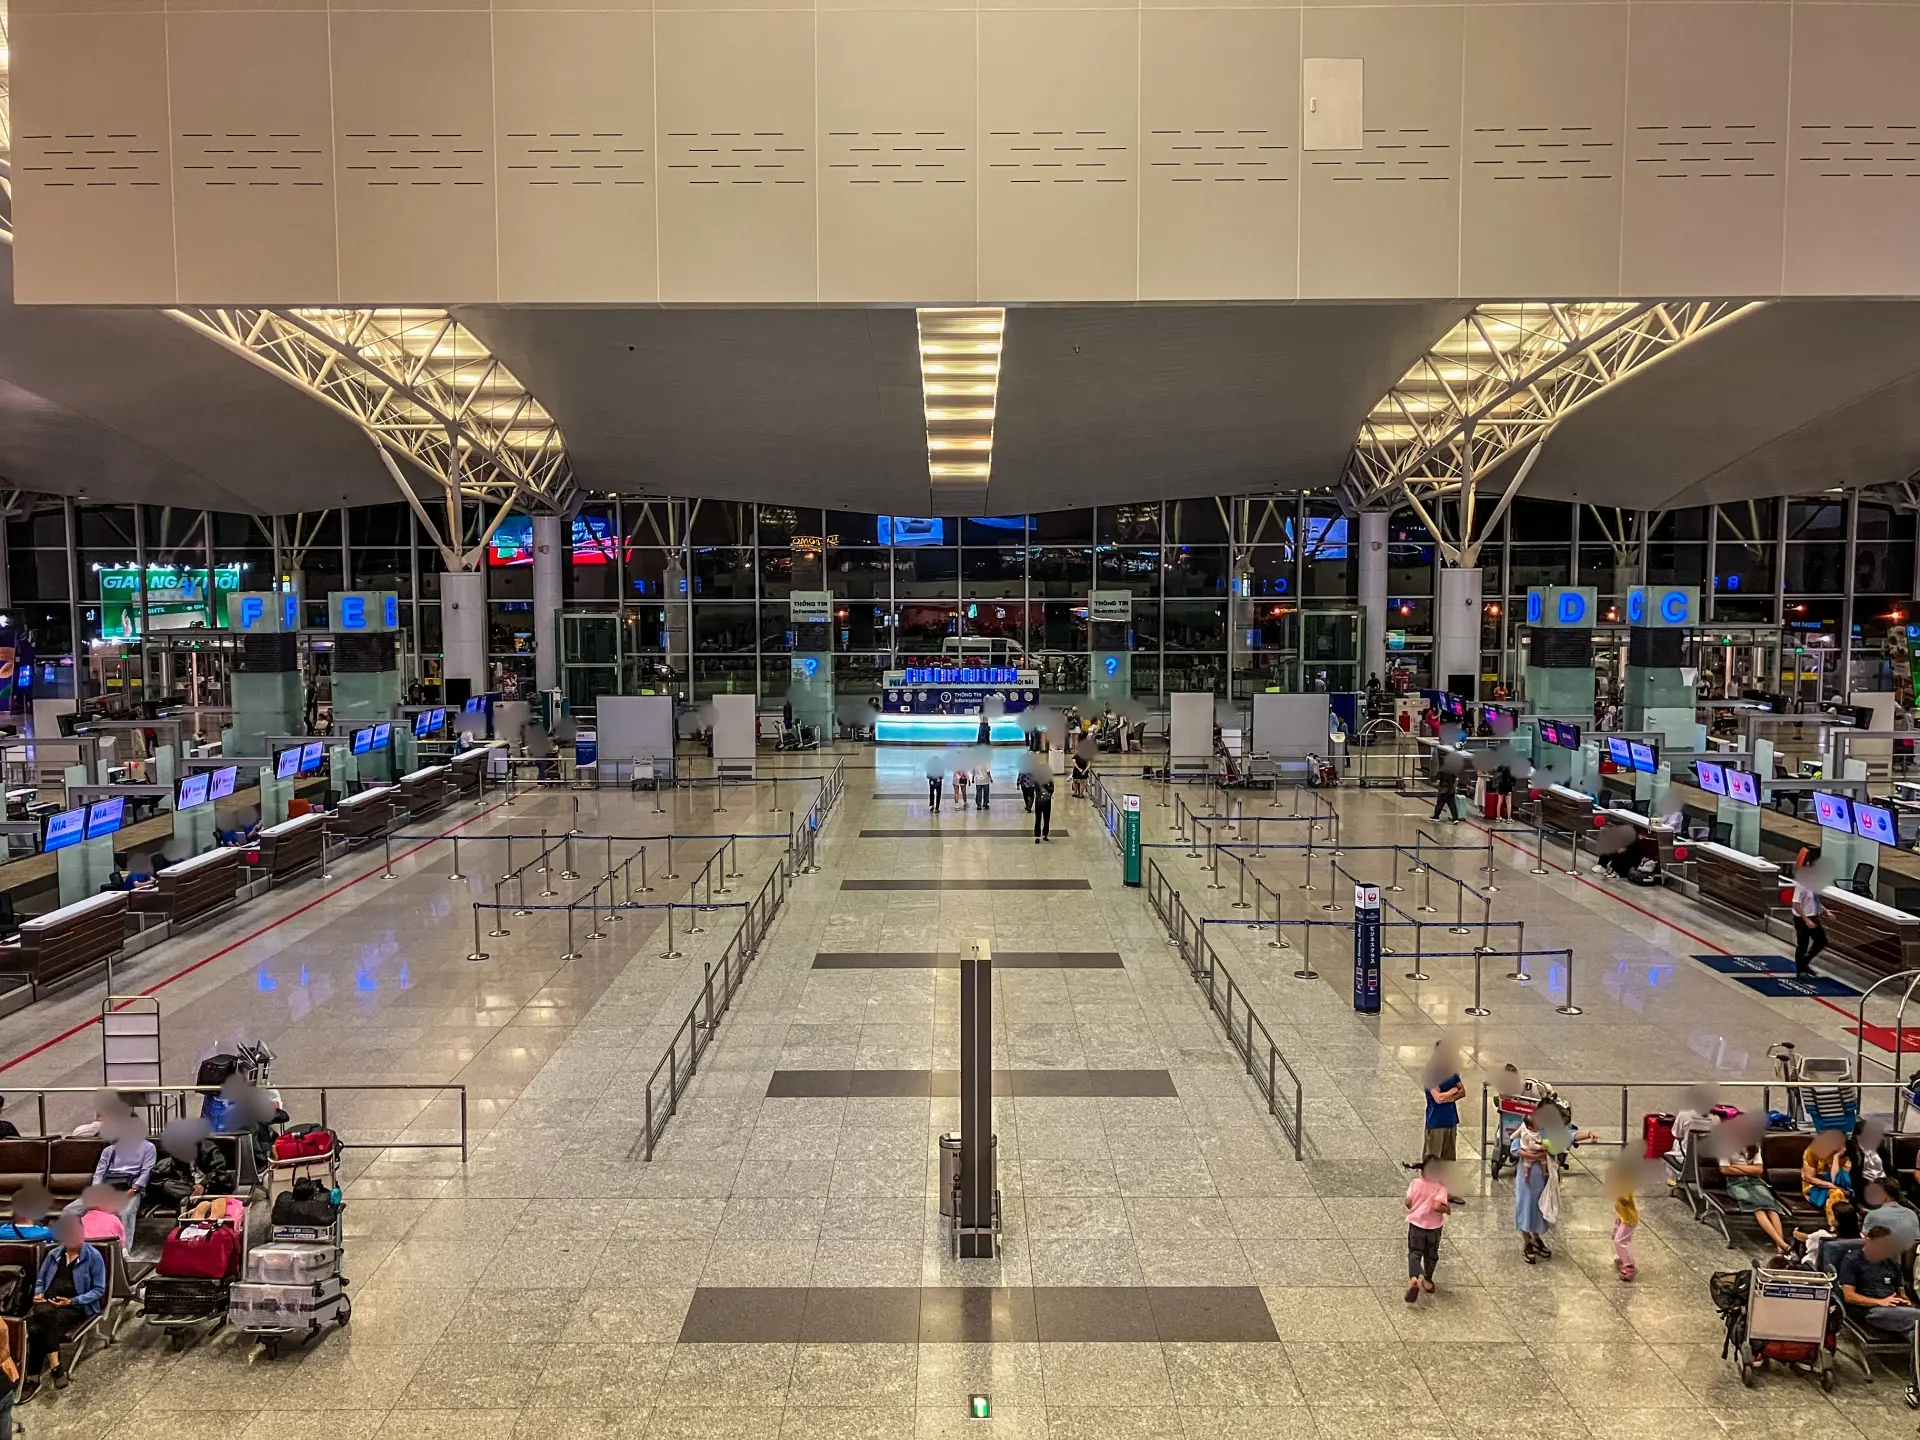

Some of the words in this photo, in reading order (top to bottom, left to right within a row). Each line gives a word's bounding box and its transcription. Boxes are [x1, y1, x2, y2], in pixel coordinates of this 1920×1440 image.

[241, 597, 263, 628] F
[285, 597, 297, 628] F
[341, 597, 366, 628] E
[384, 597, 397, 626] E
[1558, 592, 1586, 623] D
[1629, 591, 1643, 621] C
[1660, 591, 1688, 624] C
[51, 820, 67, 832] NIA
[93, 808, 107, 820] NIA
